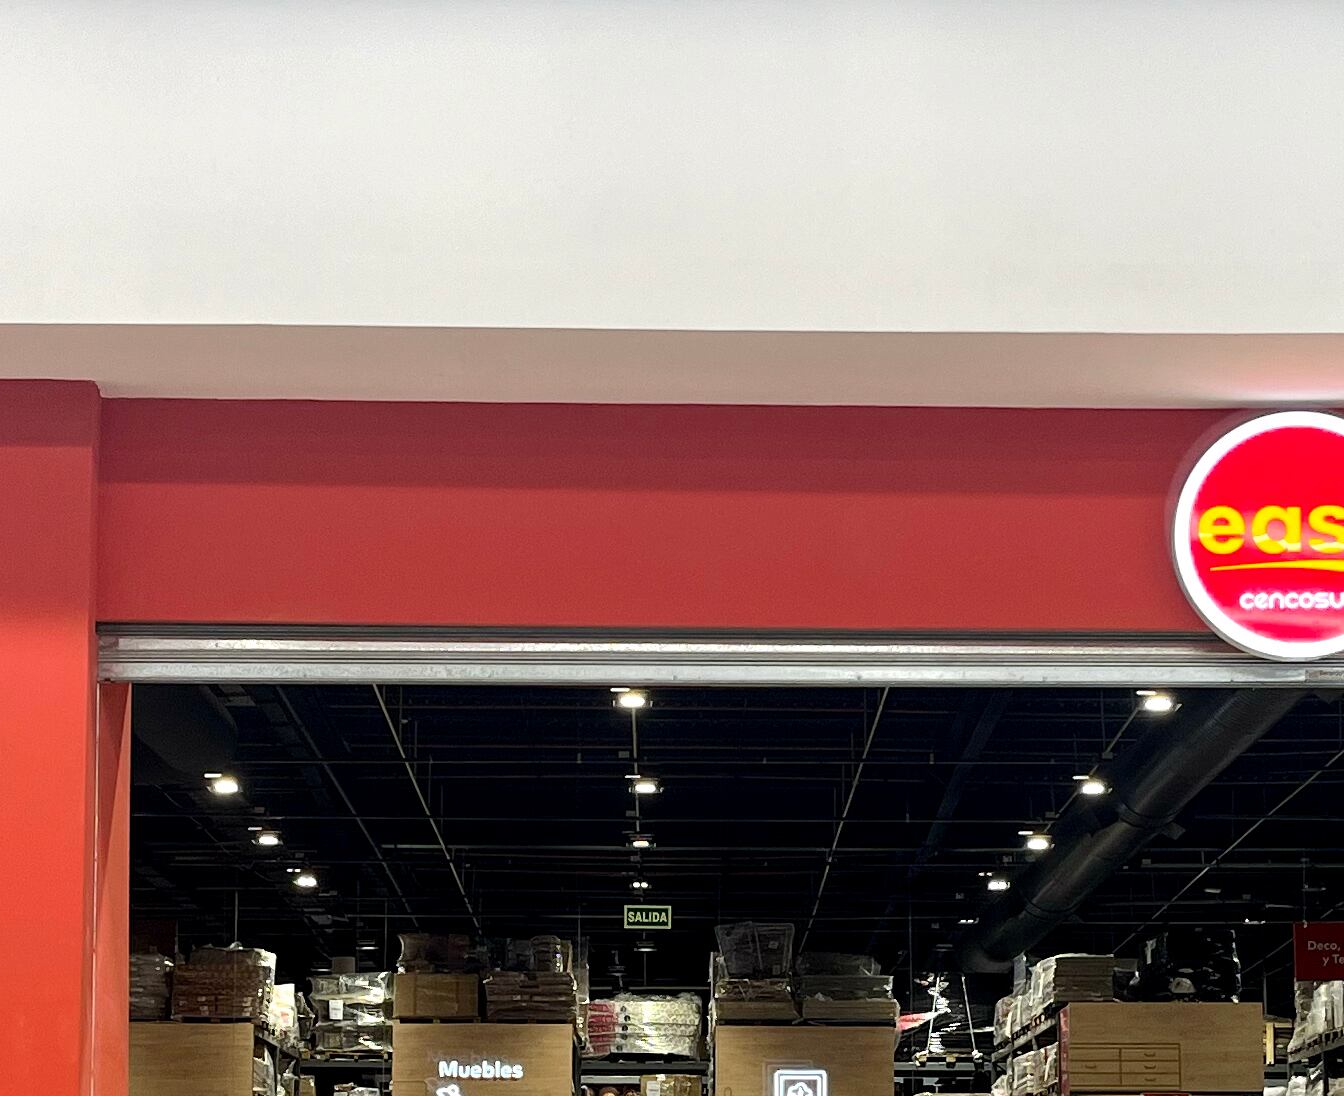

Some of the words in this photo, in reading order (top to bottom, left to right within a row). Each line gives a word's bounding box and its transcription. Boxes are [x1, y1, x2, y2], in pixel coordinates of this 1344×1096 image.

[627, 911, 668, 923] SALIDA
[1307, 940, 1341, 951] Deco,
[1322, 956, 1329, 967] y
[438, 1060, 524, 1079] Muebles
